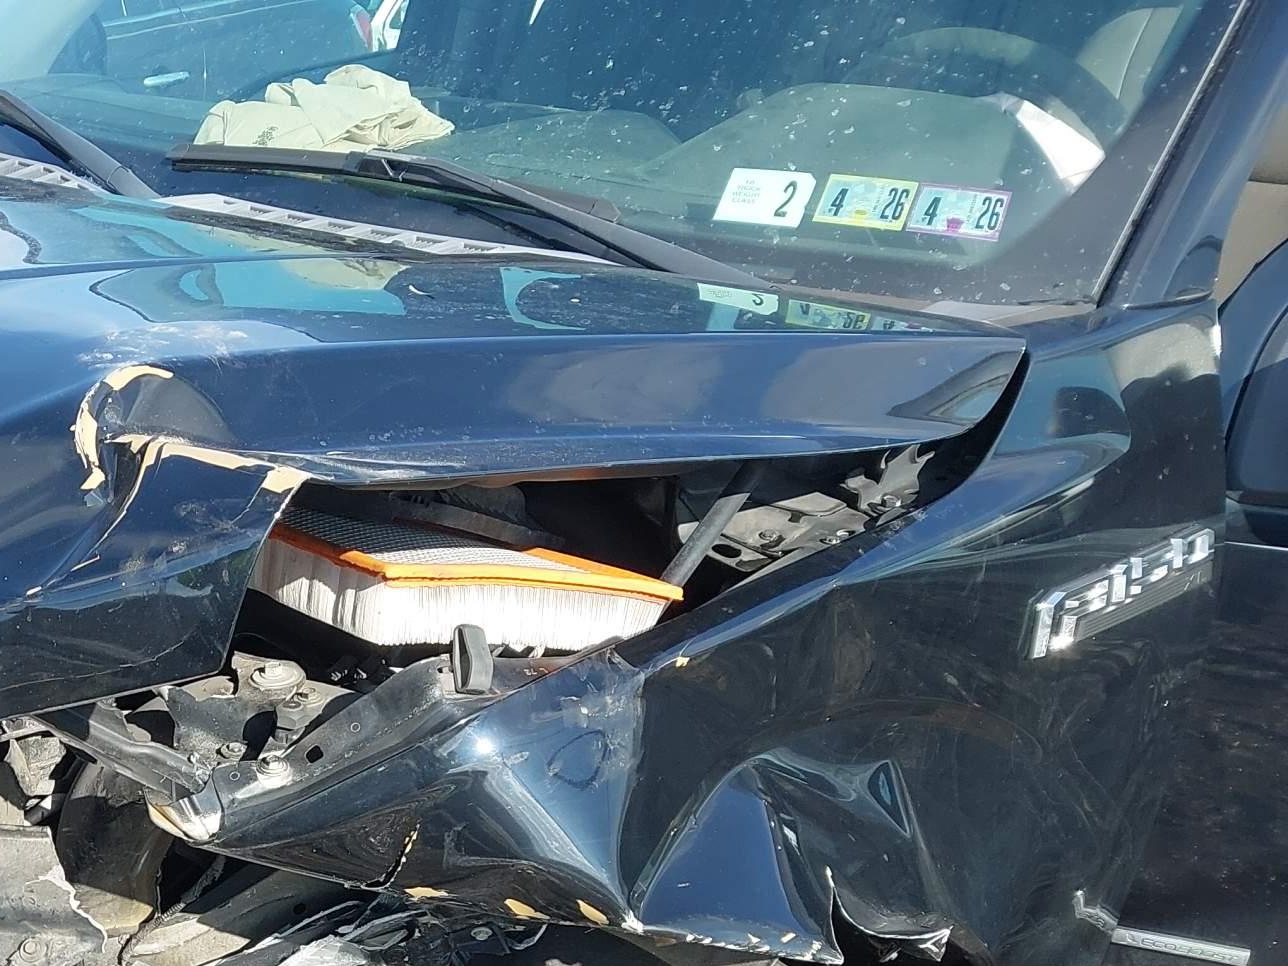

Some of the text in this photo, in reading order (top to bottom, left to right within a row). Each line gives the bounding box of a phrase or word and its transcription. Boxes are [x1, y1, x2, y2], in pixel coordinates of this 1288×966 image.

[774, 180, 798, 217] 2
[829, 188, 849, 217] 4
[879, 187, 911, 221] 26
[923, 196, 943, 227] 4
[974, 196, 1005, 231] 26
